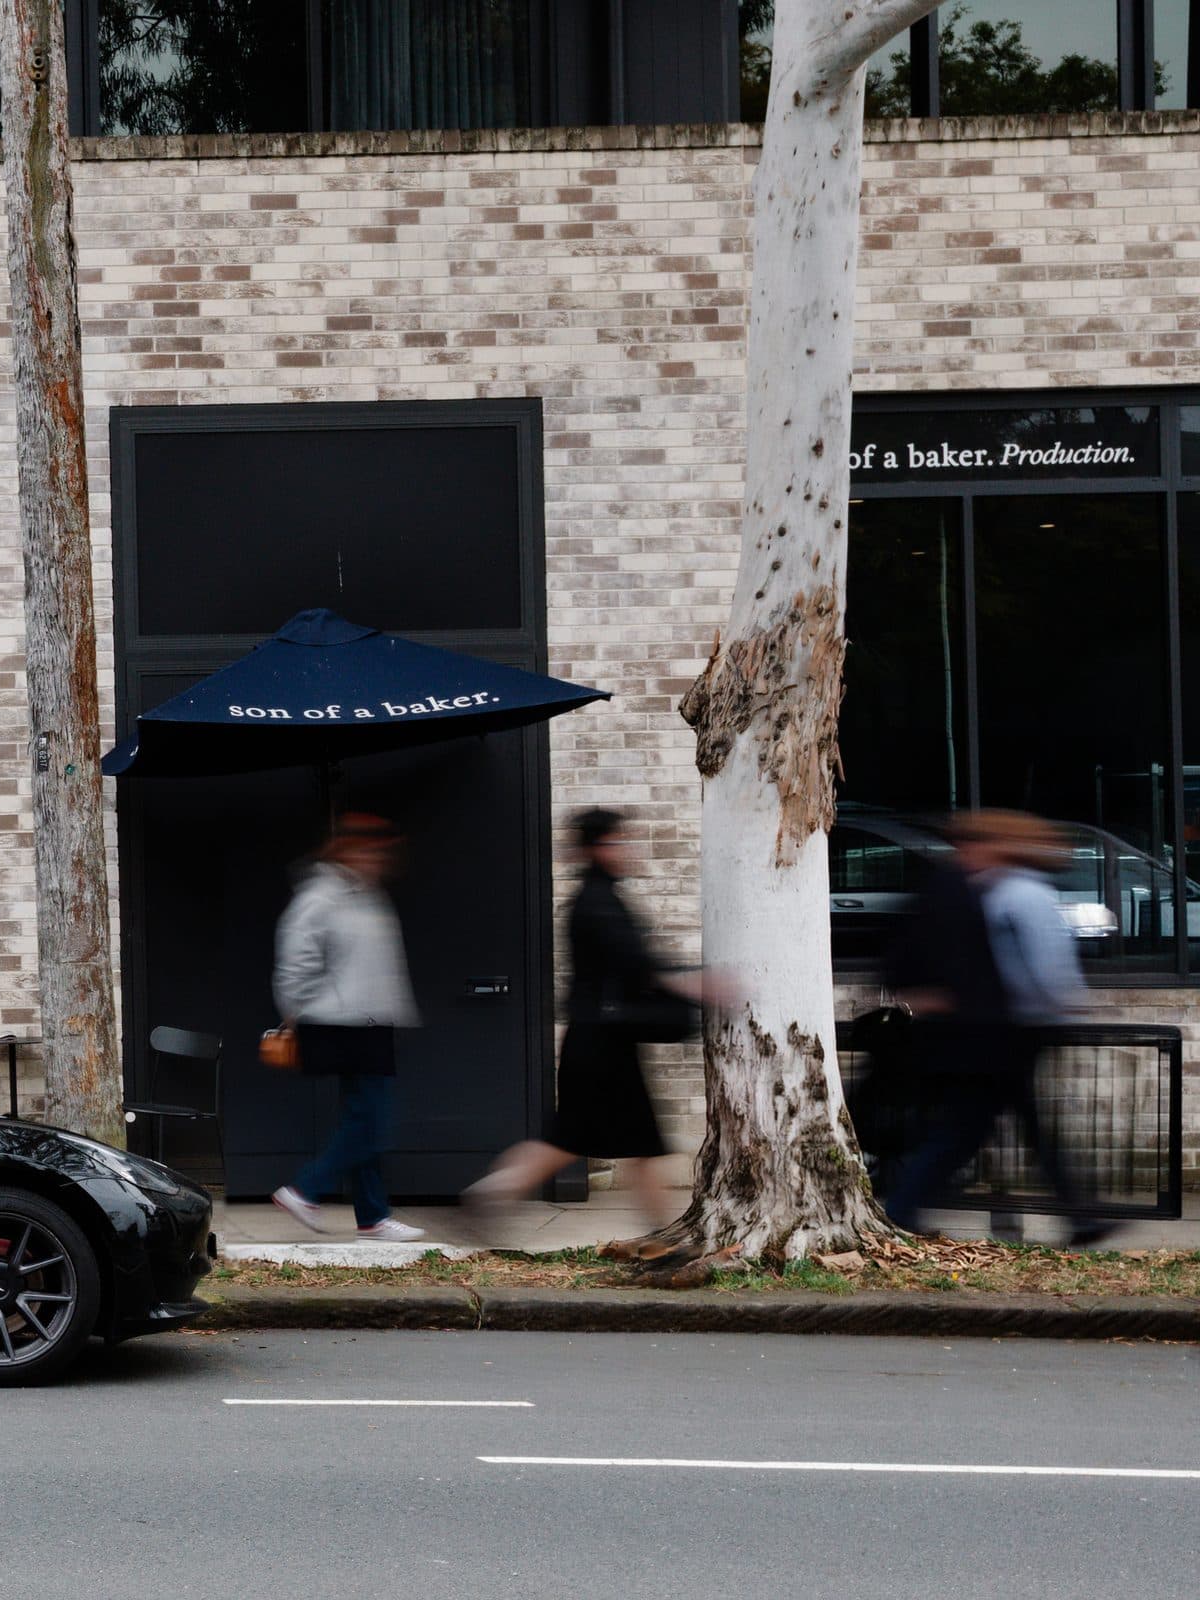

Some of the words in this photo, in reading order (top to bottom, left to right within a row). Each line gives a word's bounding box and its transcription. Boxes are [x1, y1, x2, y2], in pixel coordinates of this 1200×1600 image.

[883, 451, 899, 469] a
[906, 441, 994, 469] baker.
[999, 440, 1135, 466] Production.
[228, 704, 293, 719] son
[303, 703, 342, 719] of
[352, 707, 376, 719] a
[381, 690, 501, 717] baker.
